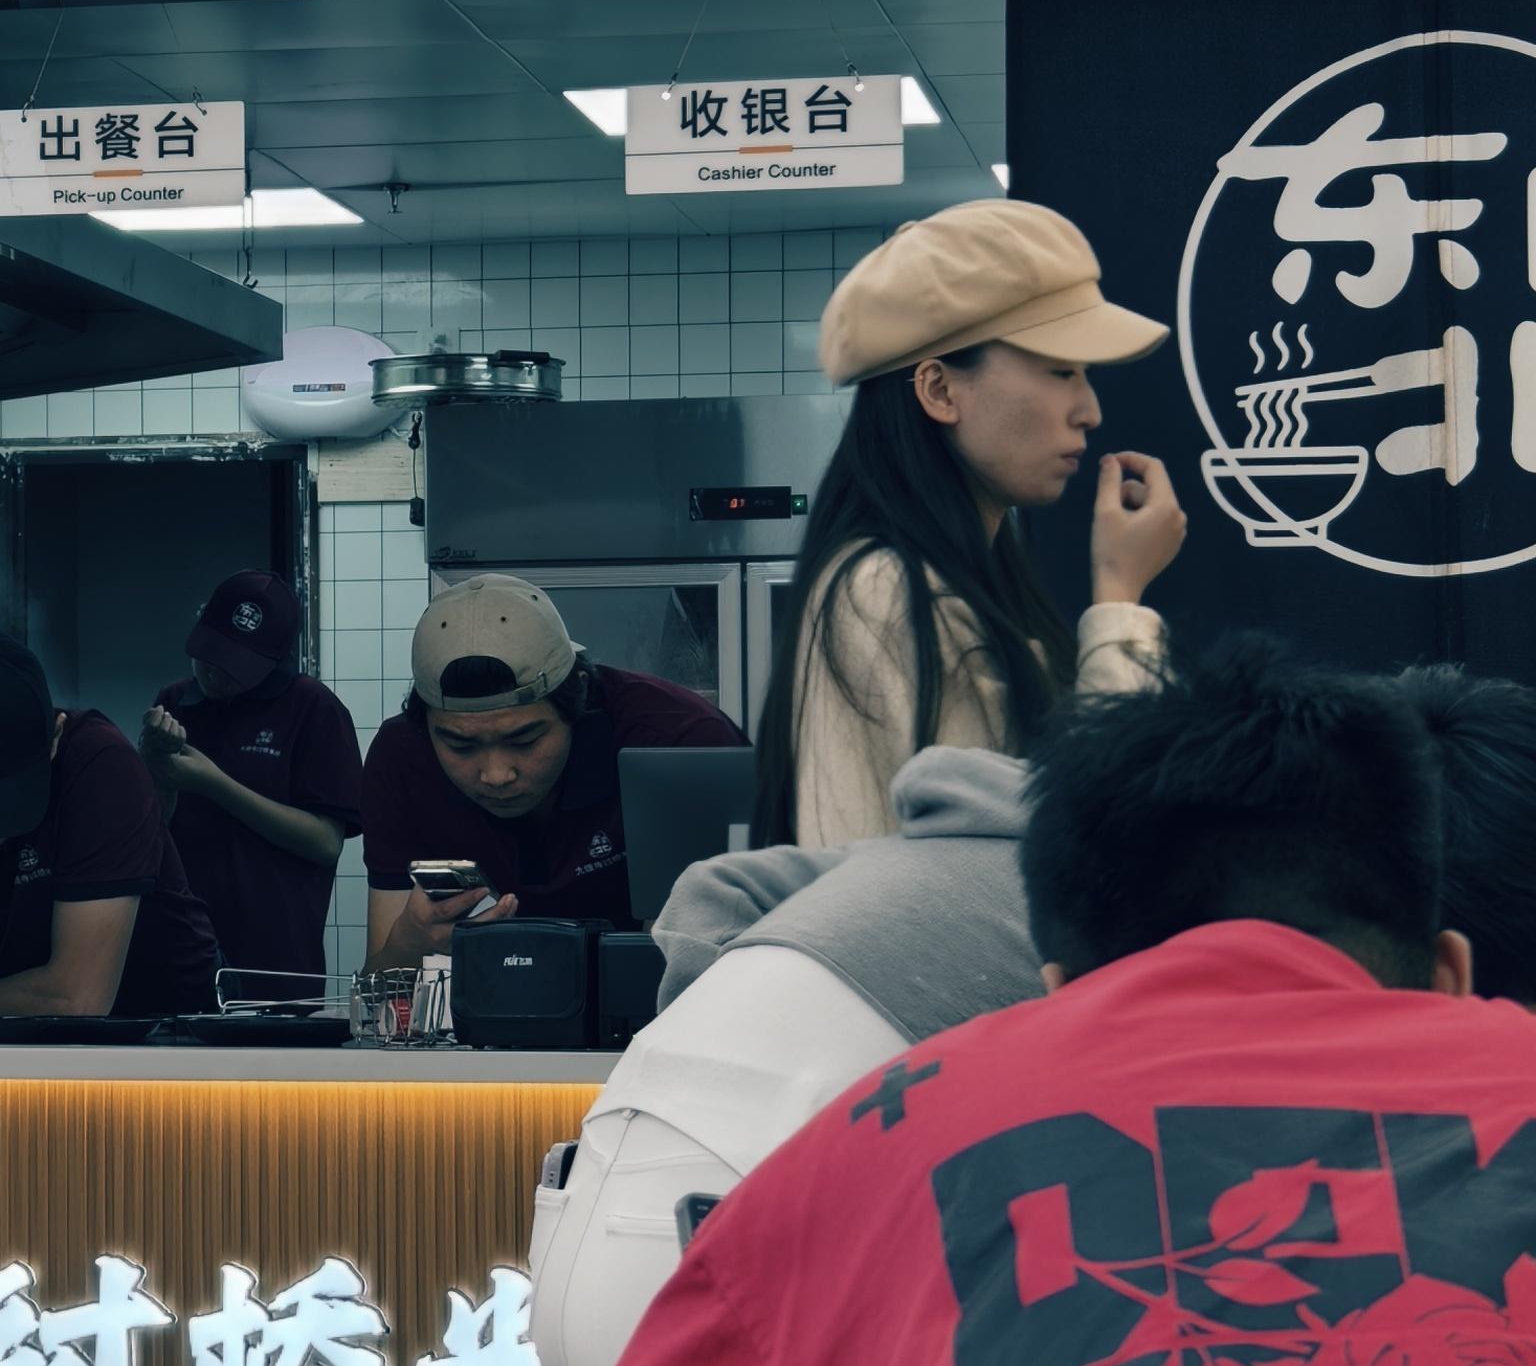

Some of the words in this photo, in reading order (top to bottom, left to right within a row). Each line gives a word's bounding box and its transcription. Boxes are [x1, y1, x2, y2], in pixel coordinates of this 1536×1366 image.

[680, 85, 852, 138] 收银台
[39, 111, 199, 161] 出餐台
[698, 165, 763, 182] Cashier
[768, 162, 836, 178] Counter
[53, 189, 116, 204] Pick-up
[121, 187, 184, 202] Counter
